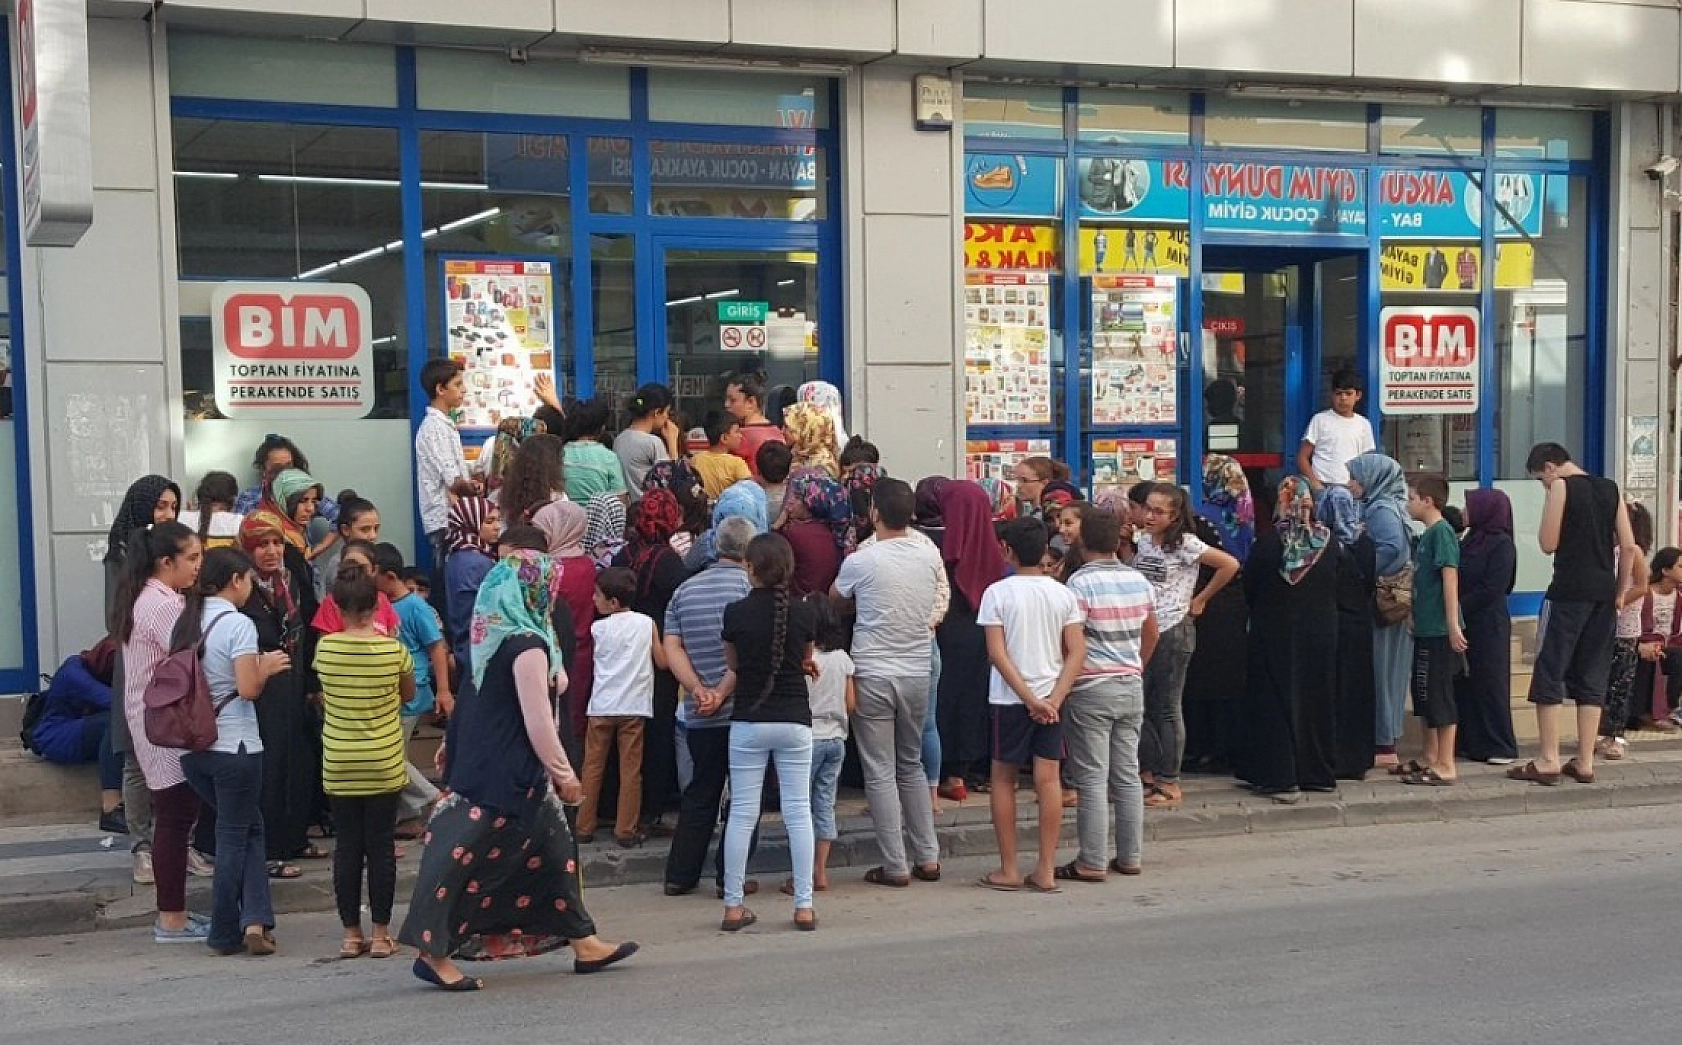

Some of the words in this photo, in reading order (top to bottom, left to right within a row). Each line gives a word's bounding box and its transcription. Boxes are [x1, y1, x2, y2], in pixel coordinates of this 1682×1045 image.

[726, 302, 761, 319] GİRİŞ
[229, 364, 288, 377] TOPTAN
[294, 361, 361, 377] FİYATINA
[1388, 371, 1427, 381] TOPTAN
[230, 386, 315, 398] PERAKENDE
[321, 386, 360, 400] SATIŞ
[1387, 389, 1444, 400] PERAKENDE
